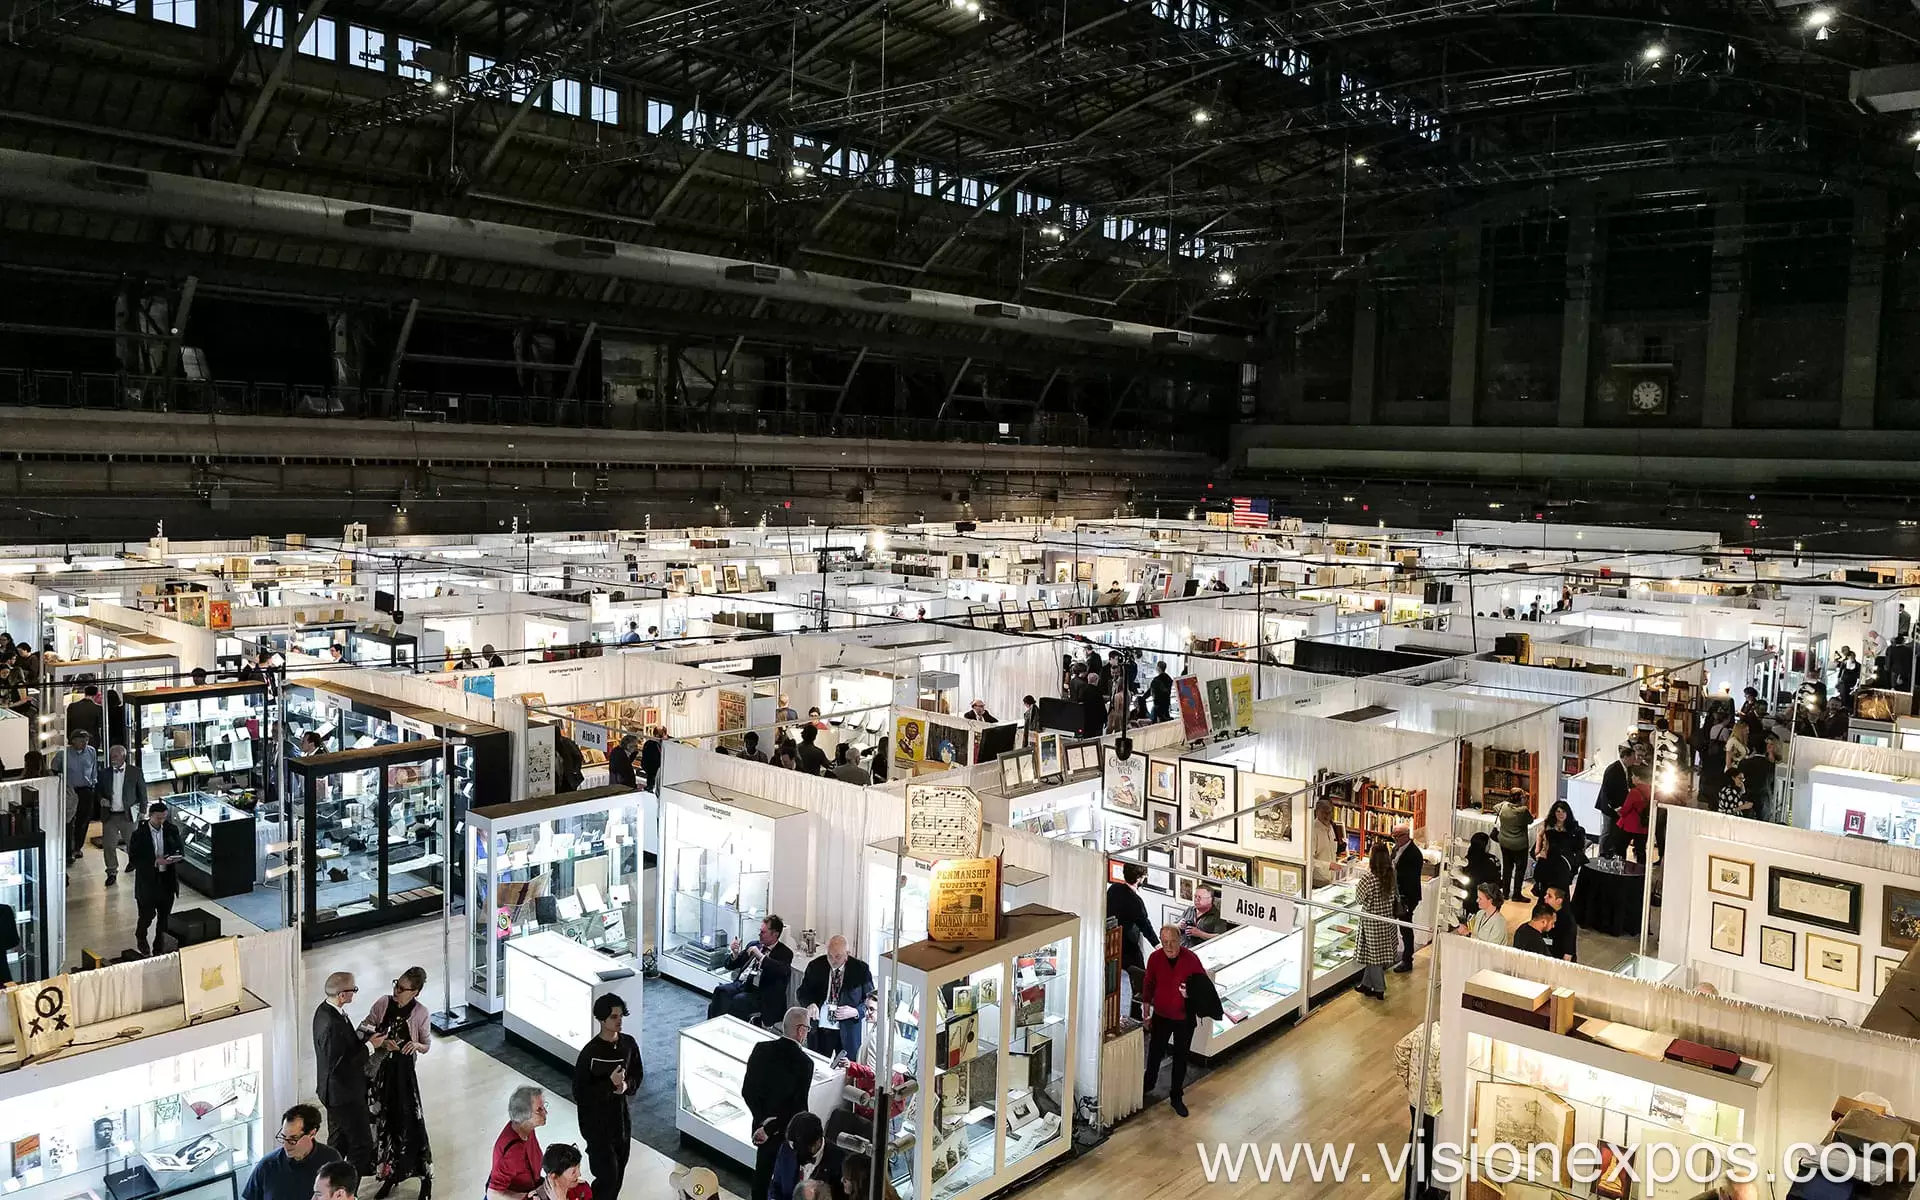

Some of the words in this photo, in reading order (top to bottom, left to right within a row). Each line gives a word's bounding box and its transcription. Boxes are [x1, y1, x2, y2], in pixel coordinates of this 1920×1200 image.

[582, 730, 595, 743] Aisle
[596, 733, 601, 744] B
[937, 869, 991, 880] PENMANSHIP
[1236, 898, 1265, 919] Aisle
[1268, 906, 1277, 922] A
[934, 913, 963, 928] BUSINESS
